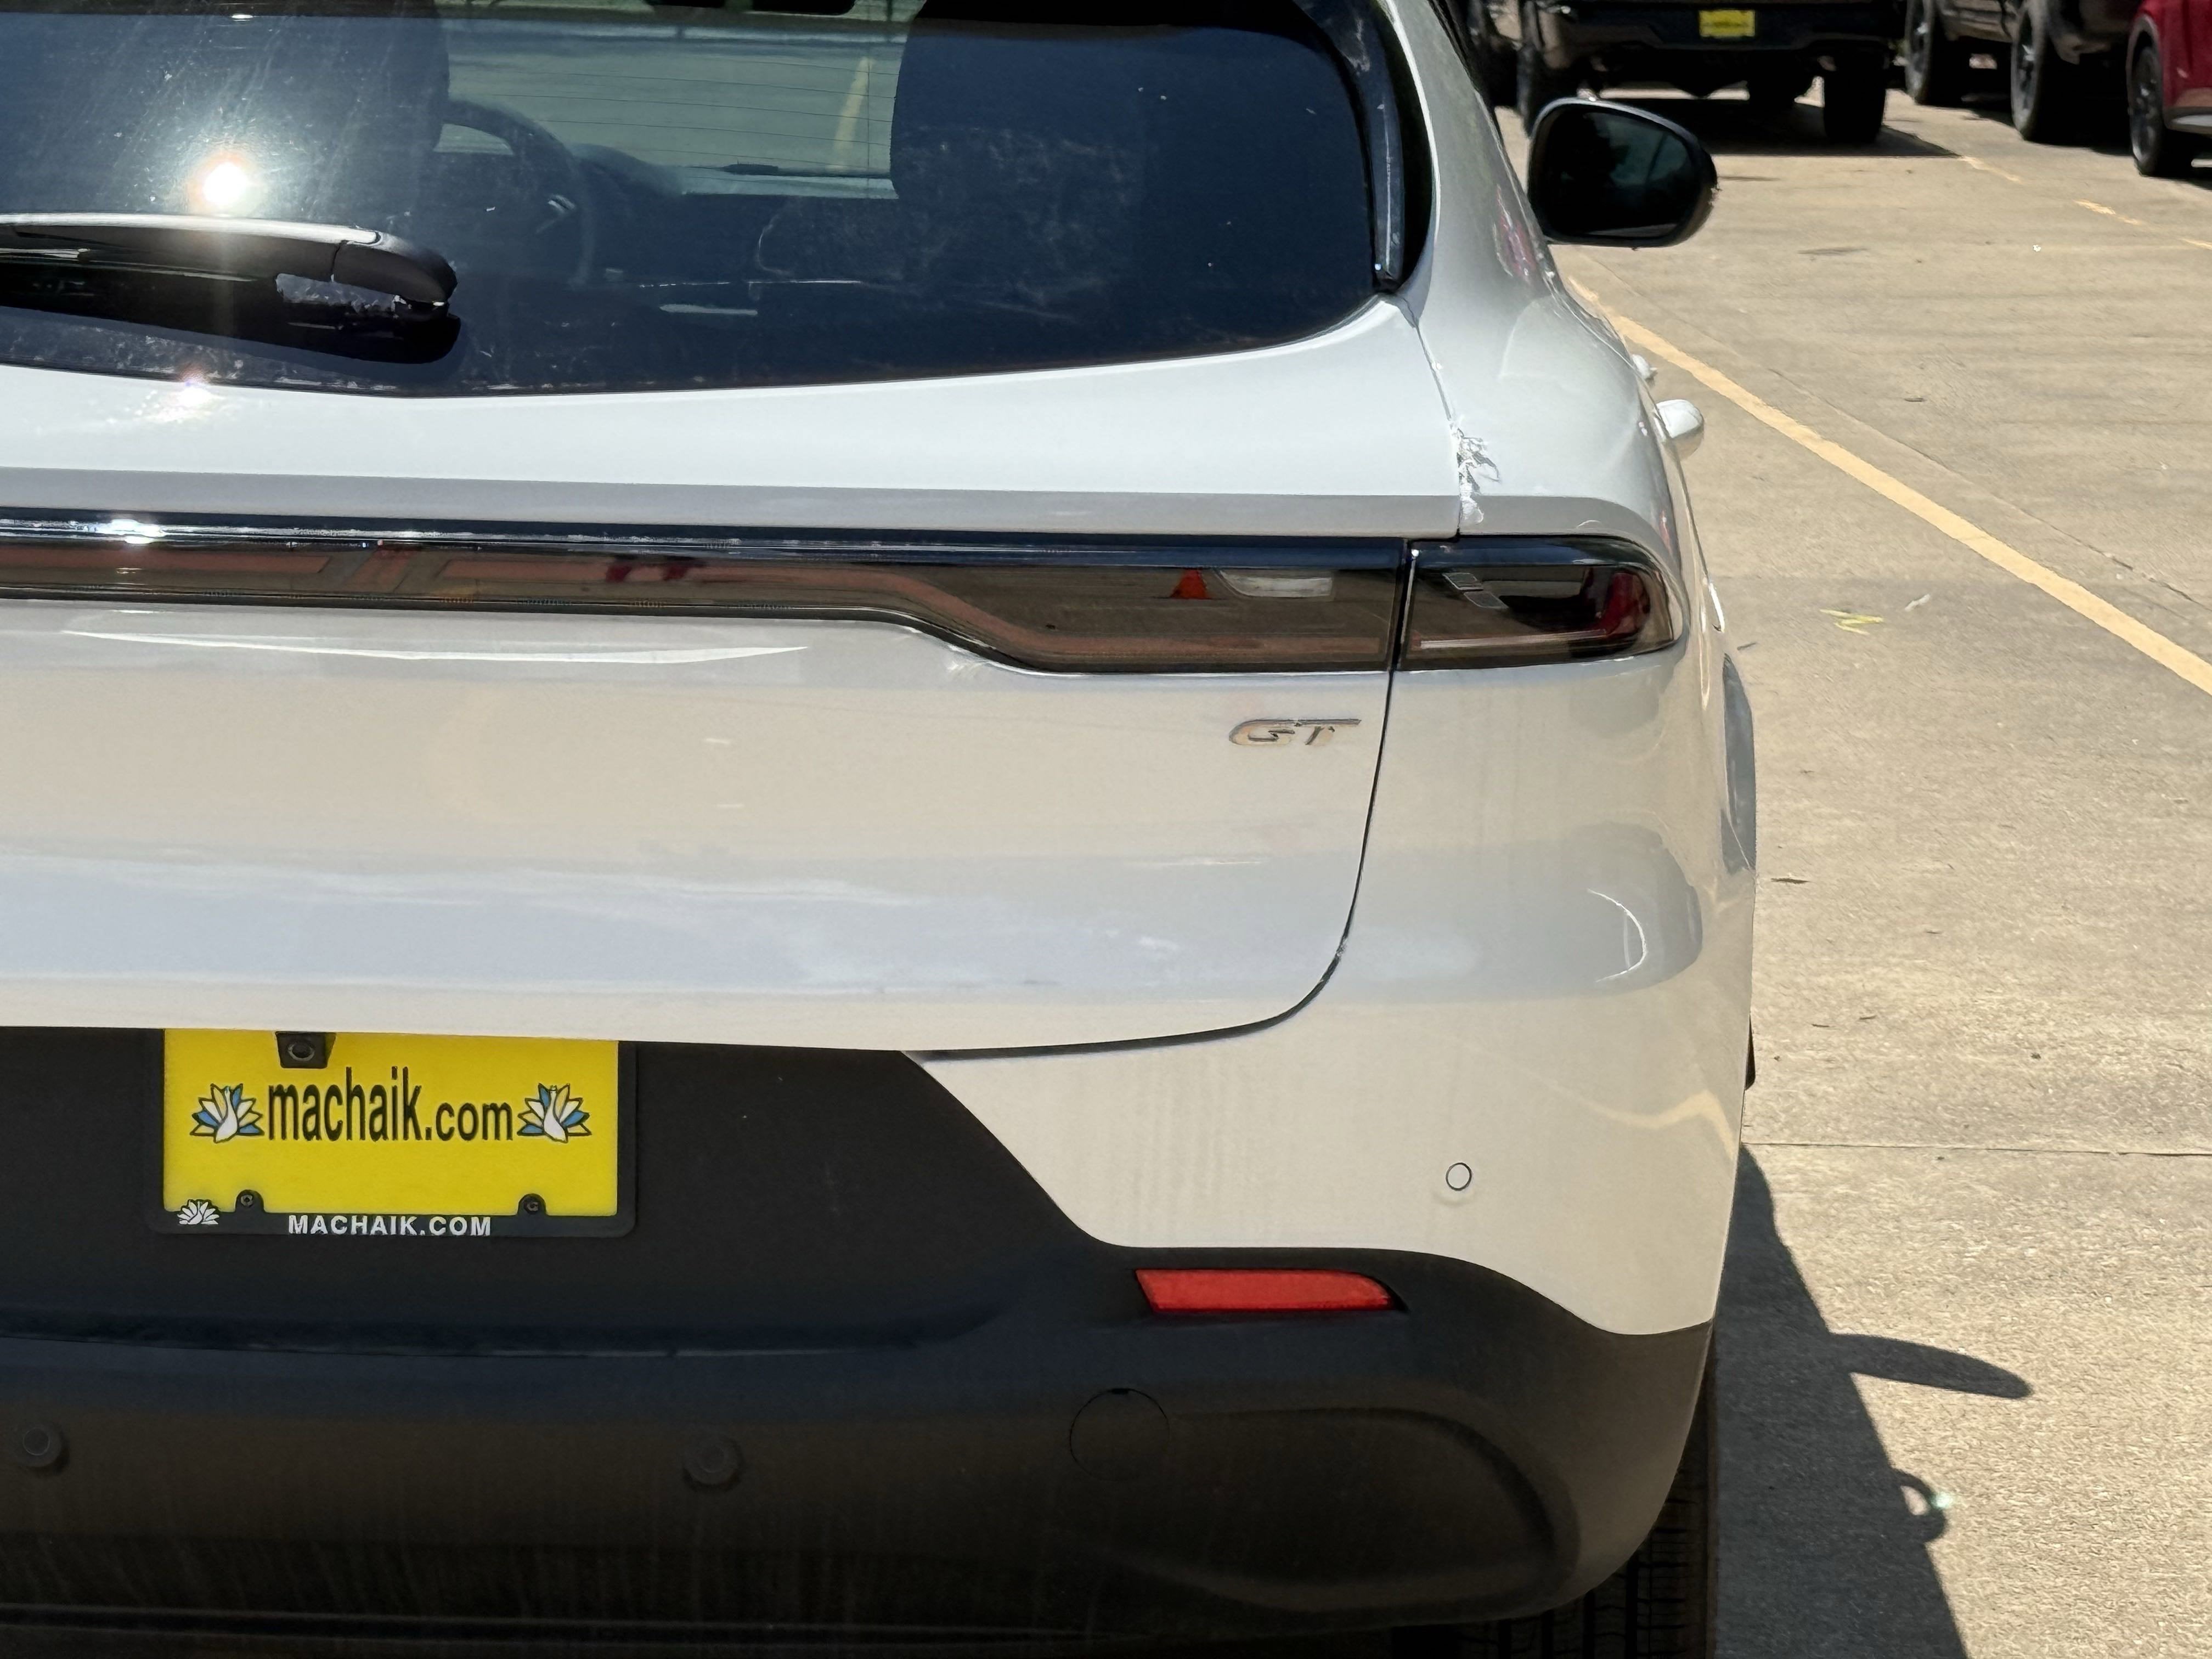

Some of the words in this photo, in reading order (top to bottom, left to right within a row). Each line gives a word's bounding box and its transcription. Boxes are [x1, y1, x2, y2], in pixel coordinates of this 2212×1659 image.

[1228, 718, 1362, 746] GT
[268, 1066, 514, 1141] machaik.com
[288, 1215, 492, 1236] MACHAIK.COM
